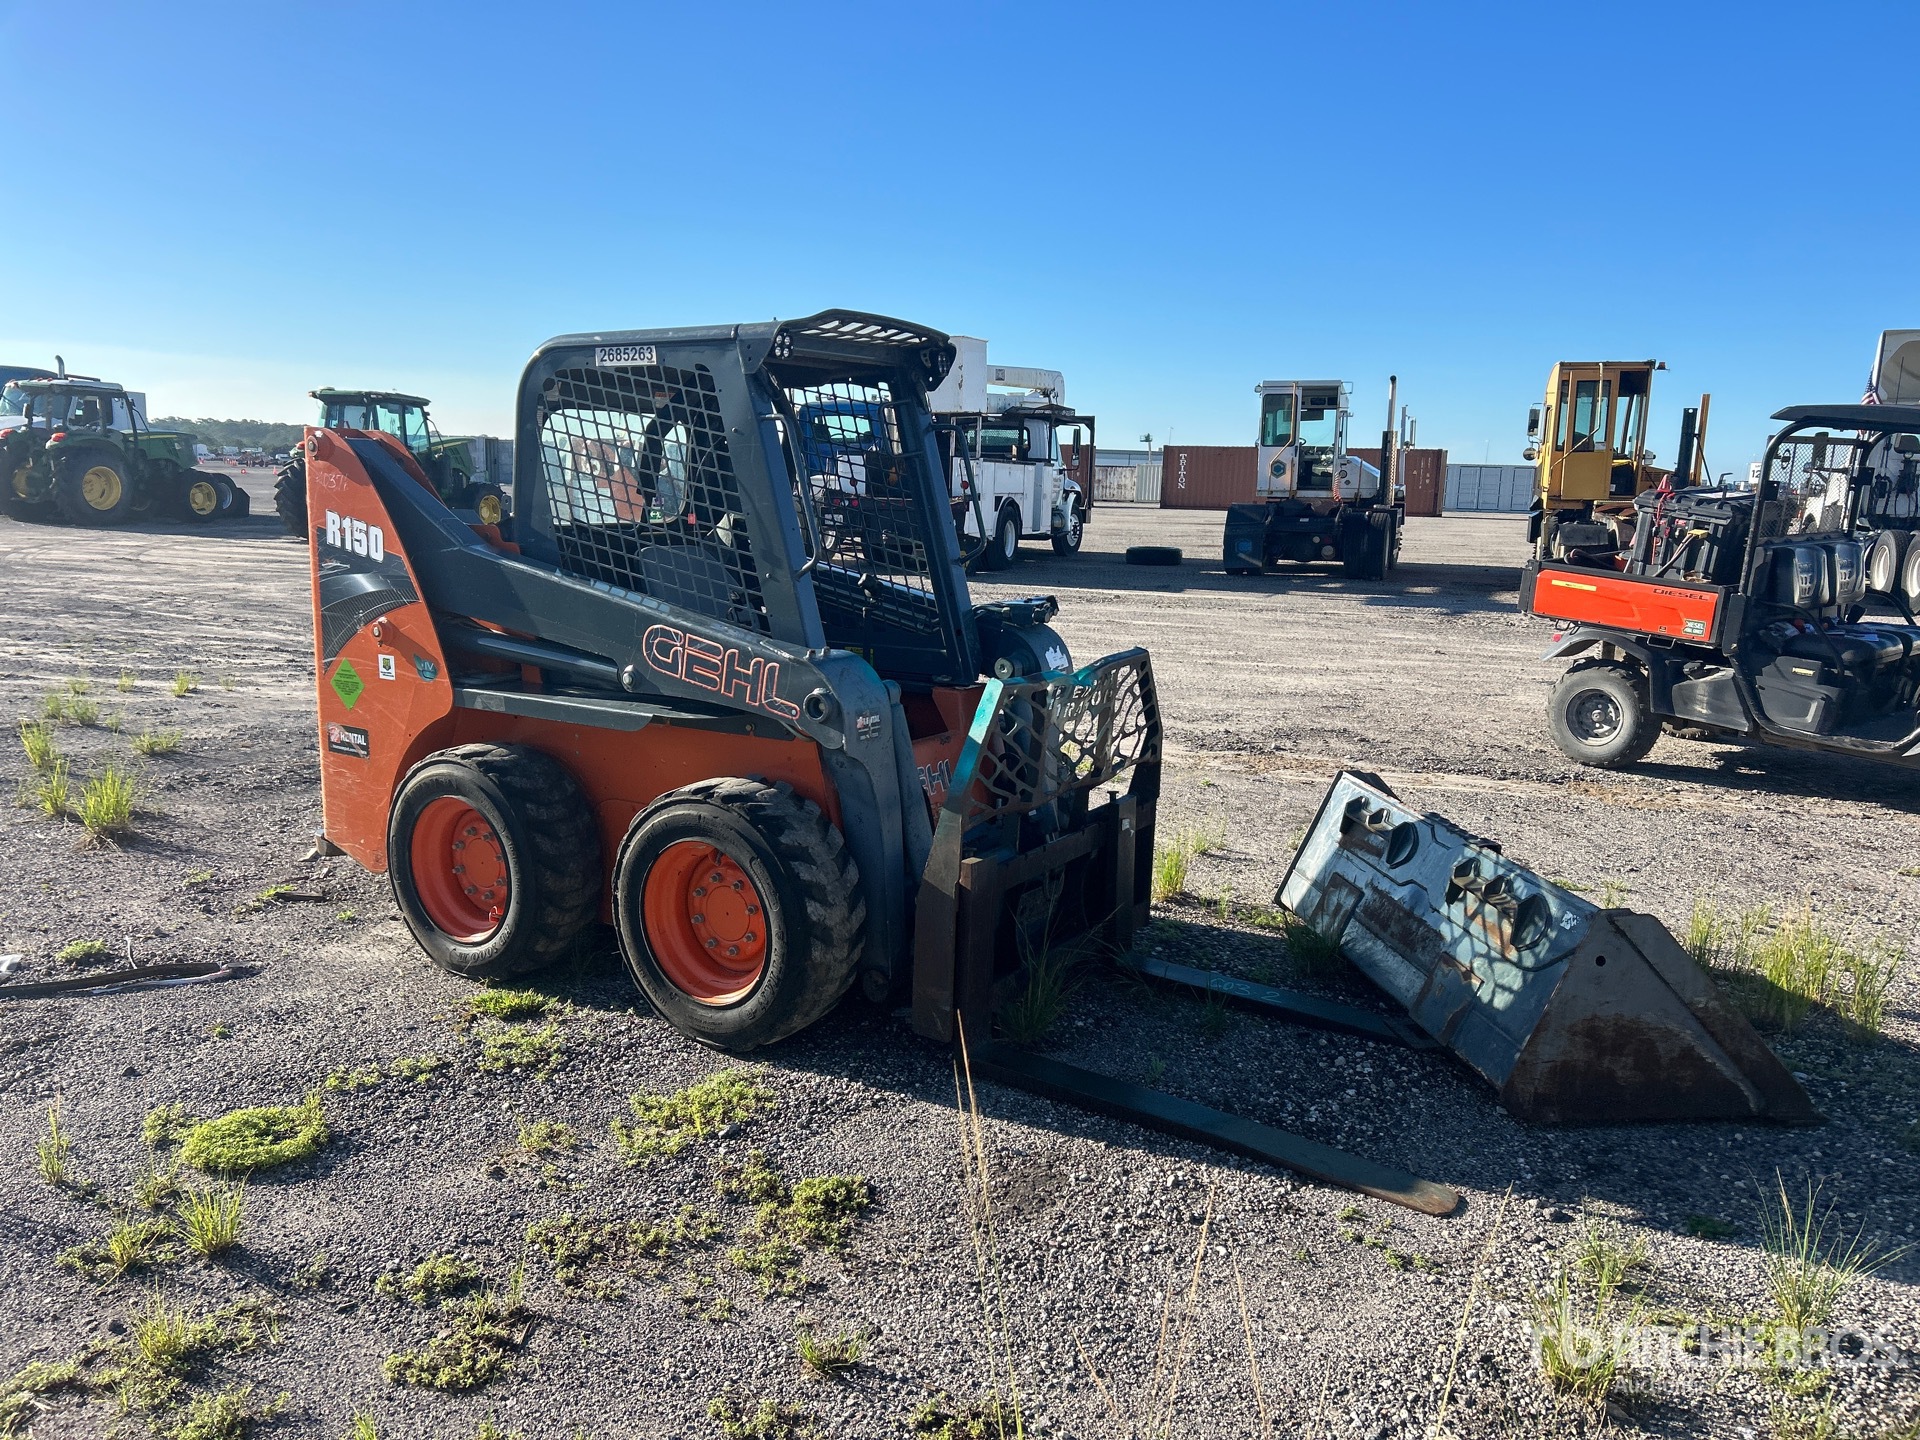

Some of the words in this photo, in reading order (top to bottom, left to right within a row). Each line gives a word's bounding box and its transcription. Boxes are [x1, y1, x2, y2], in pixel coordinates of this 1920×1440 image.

[600, 346, 654, 363] 2685263
[1178, 453, 1187, 489] TRITON
[325, 508, 384, 563] R150
[1653, 588, 1709, 601] DIESEL
[643, 624, 800, 720] GEHL
